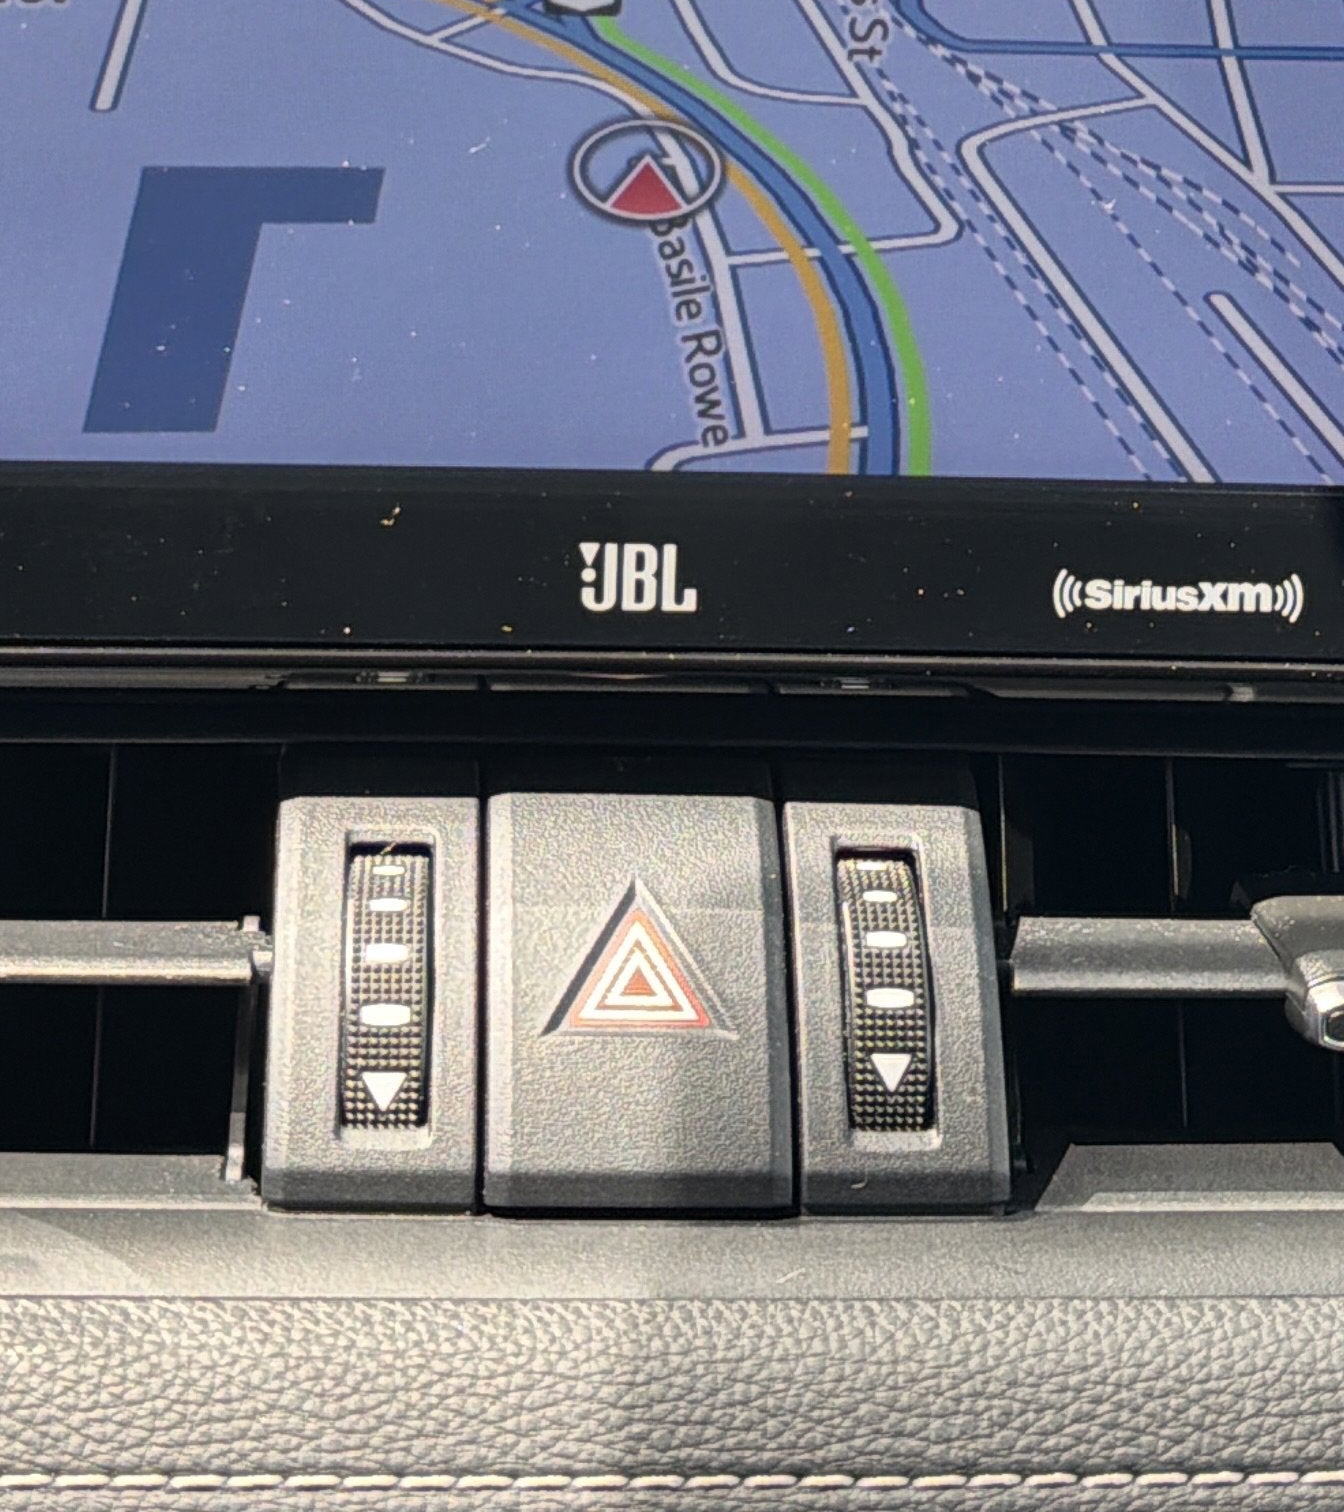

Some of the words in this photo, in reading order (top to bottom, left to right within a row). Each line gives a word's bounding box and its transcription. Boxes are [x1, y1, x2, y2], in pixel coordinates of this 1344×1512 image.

[848, 17, 889, 64] St
[681, 329, 729, 448] Rowe
[579, 542, 698, 612] JBL
